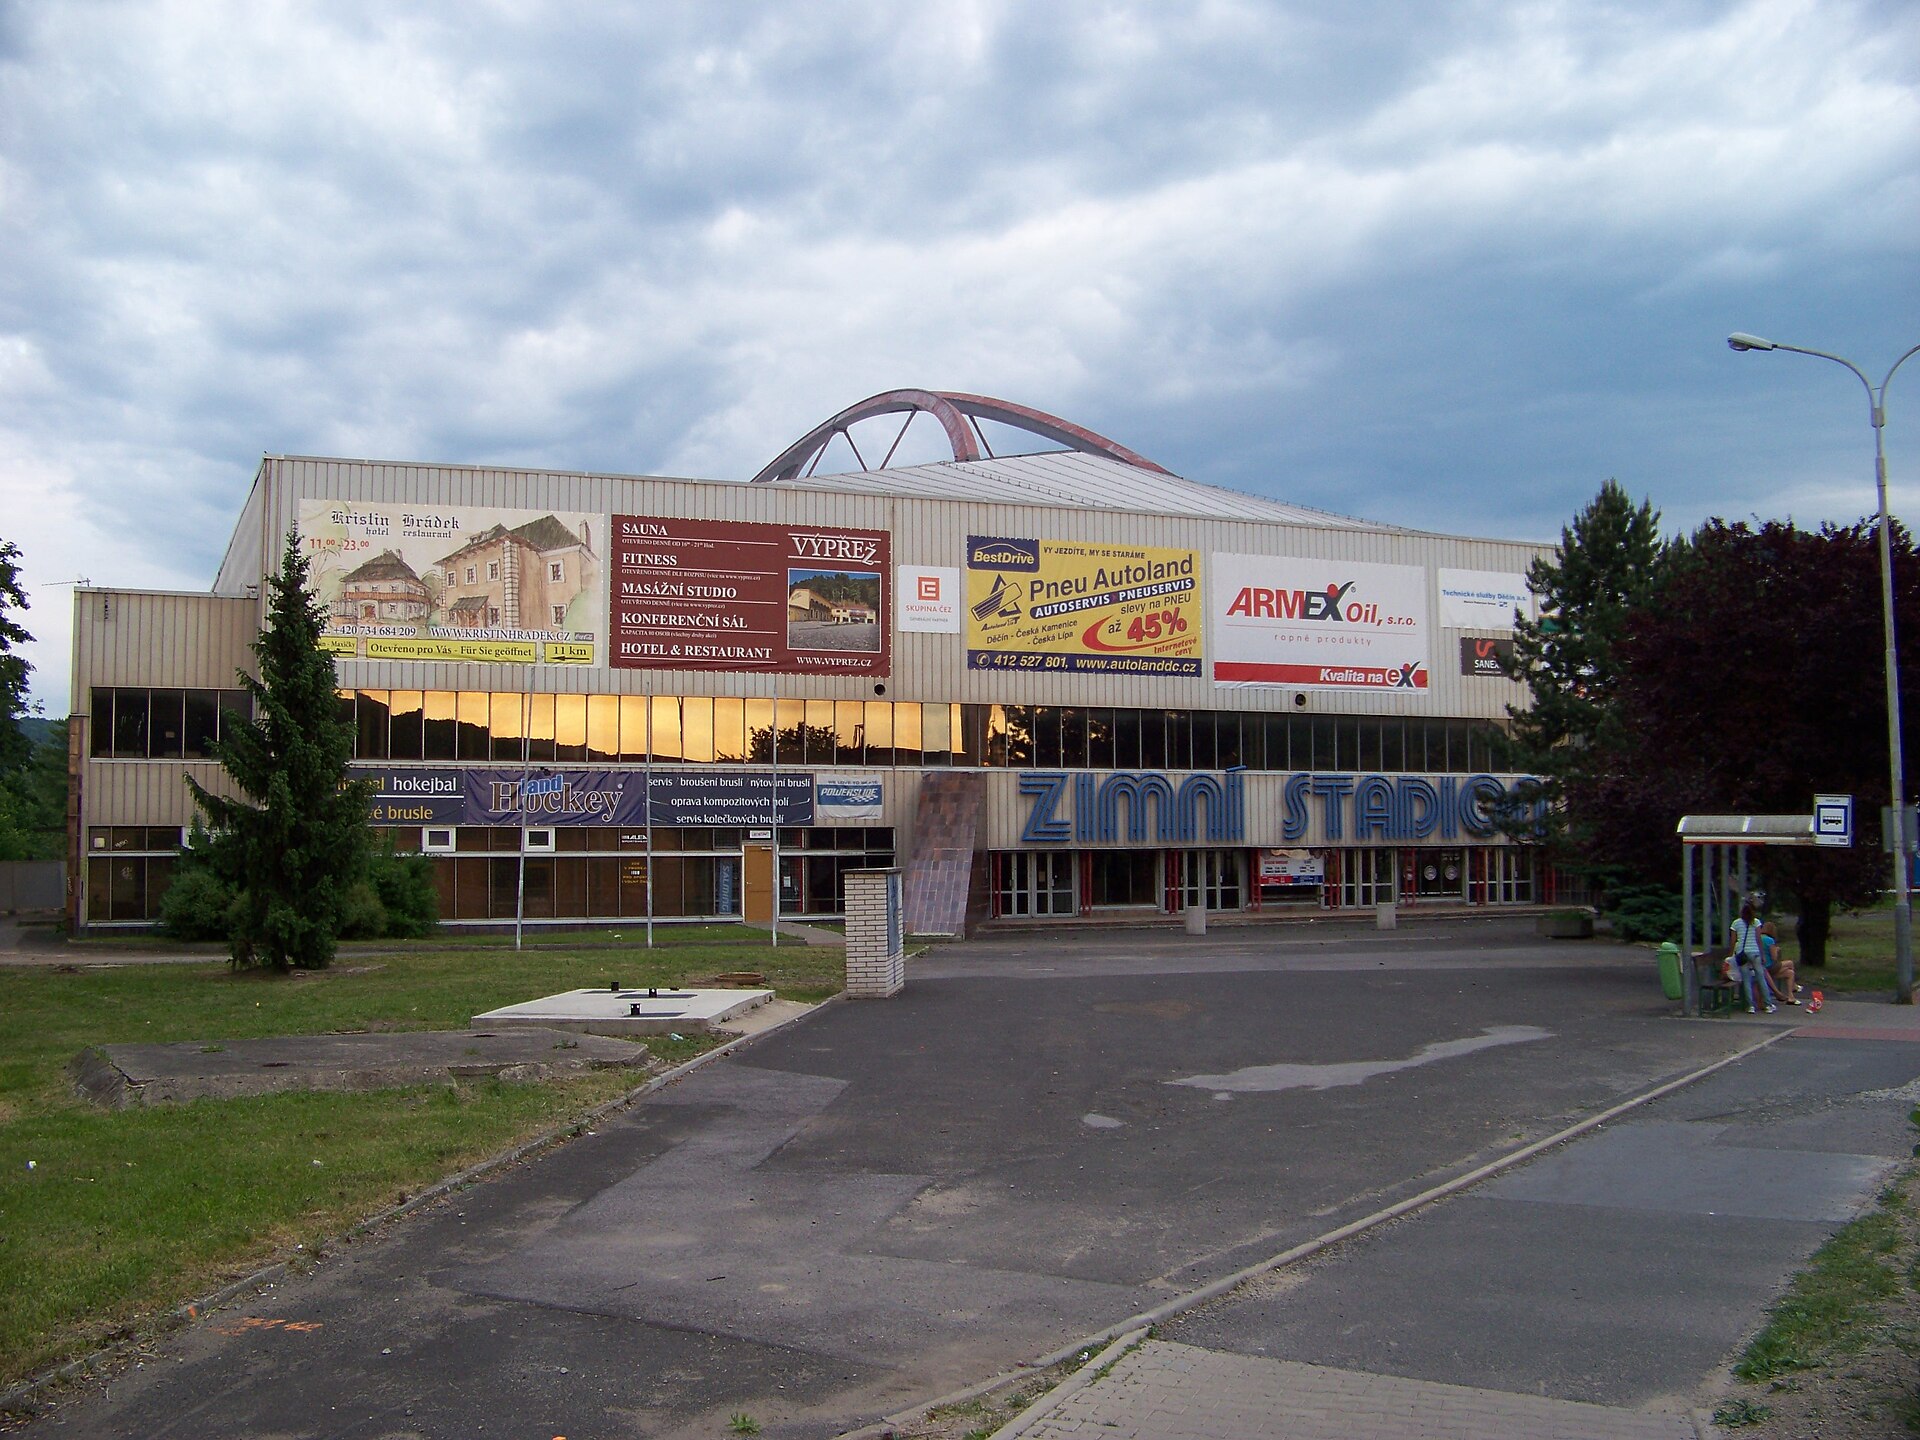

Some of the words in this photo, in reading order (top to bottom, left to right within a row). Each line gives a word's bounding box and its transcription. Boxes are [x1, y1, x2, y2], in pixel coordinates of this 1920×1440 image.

[331, 510, 390, 526] Kristin
[402, 514, 460, 530] Hrádek
[365, 527, 390, 536] hotel
[402, 529, 453, 539] restaurant
[622, 523, 668, 537] SAUNA
[791, 533, 878, 565] VÝPŘEŽ
[1044, 546, 1053, 554] VY
[1054, 546, 1087, 557] JEZDÍTE,
[1101, 549, 1111, 557] SE
[1112, 550, 1145, 559] STARÁME
[622, 552, 677, 566] FITNESS
[973, 550, 1036, 565] BestDrive
[1030, 575, 1088, 602] Pneu
[1093, 553, 1195, 591] Autoland
[621, 580, 684, 597] MASÁŽNÍ
[687, 585, 737, 598] STUDIO
[1442, 589, 1475, 598] Technické
[1476, 592, 1496, 600] služby
[1497, 593, 1515, 601] Děčín
[1034, 593, 1111, 618] AUTOSERVIS
[1118, 577, 1193, 602] PNEUSERVIS
[1120, 602, 1146, 615] slevy
[1149, 600, 1161, 610] na
[1164, 593, 1191, 607] PNEU
[1225, 581, 1354, 622] ARMEX
[1345, 602, 1383, 627] Oil,
[1386, 615, 1416, 627] s.r.o.
[905, 604, 938, 612] SKUPINA
[939, 604, 952, 613] ČEZ
[621, 612, 719, 627] KONFERENČNÍ
[722, 614, 748, 629] SÁL
[1108, 619, 1122, 634] až
[1127, 606, 1188, 643] 45%
[334, 626, 357, 635] +420
[360, 626, 377, 636] 734
[379, 627, 397, 637] 684
[399, 627, 417, 637] 209
[430, 628, 571, 642] WWW.KRISTINHRADEK.CZ
[986, 633, 1009, 644] Děčín
[1015, 627, 1040, 639] Česká
[1041, 619, 1078, 632] Kamenice
[1032, 634, 1056, 645] Česká
[1057, 630, 1074, 642] Lípa
[1153, 636, 1198, 655] Internetové
[1274, 633, 1310, 645] ropné
[1317, 635, 1372, 648] produkty
[370, 643, 414, 655] Otevřeno
[417, 645, 433, 656] pro
[436, 644, 452, 654] Vás
[461, 645, 477, 655] Für
[479, 646, 493, 655] Sie
[495, 646, 532, 658] geöffnet
[554, 646, 566, 655] 11
[569, 646, 587, 656] km
[621, 642, 668, 655] HOTEL
[670, 643, 681, 656] &
[685, 645, 773, 658] RESTAURANT
[1174, 647, 1193, 657] ceny
[994, 654, 1018, 667] 412
[1019, 655, 1043, 668] 527
[1045, 656, 1068, 670] 801,
[1076, 657, 1197, 674] www.autolanddc.cz
[1319, 667, 1365, 683] Kvalita
[1367, 673, 1383, 683] na
[393, 776, 457, 793] hokejbal
[648, 777, 673, 787] servis
[680, 777, 718, 787] broušení
[719, 777, 743, 787] bruslí
[787, 778, 811, 787] bruslí
[820, 787, 879, 797] POWERSLIDE
[488, 781, 624, 823] Hockey
[671, 799, 701, 808] oprava
[703, 797, 770, 808] kompozitových
[1018, 765, 1248, 843] ZIMNÍ
[388, 805, 434, 821] brusle
[676, 815, 702, 824] servis
[703, 814, 758, 824] kolečkových
